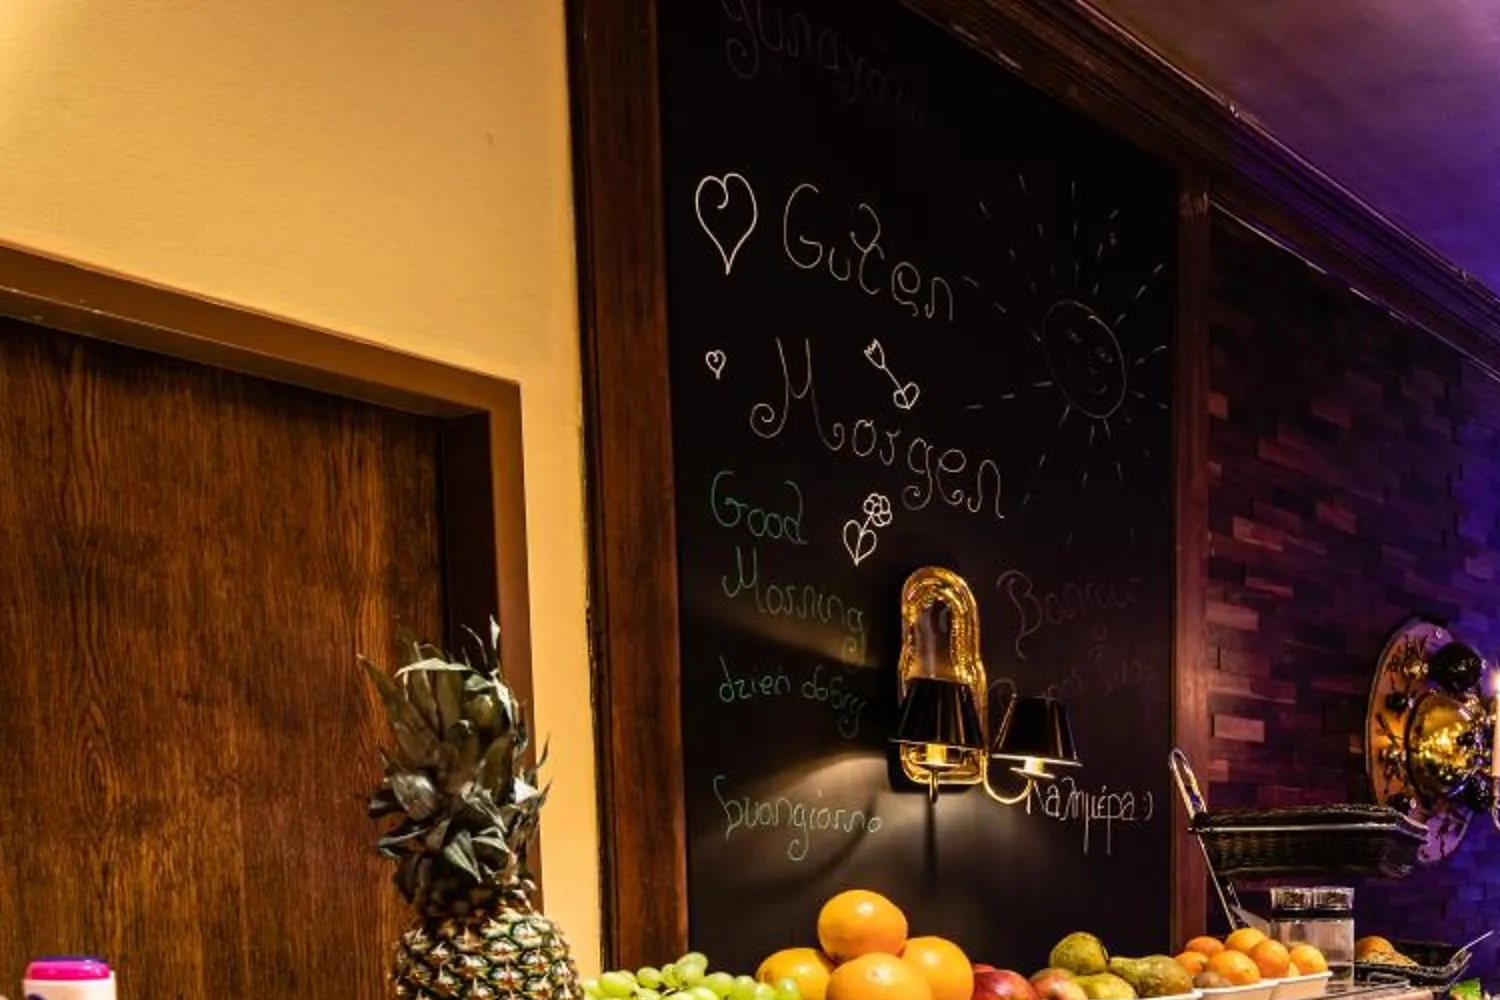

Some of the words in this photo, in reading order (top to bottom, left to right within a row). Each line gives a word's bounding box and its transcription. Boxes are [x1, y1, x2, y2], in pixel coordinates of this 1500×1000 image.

[783, 183, 954, 321] Guten
[749, 335, 1004, 519] Morgen
[710, 468, 808, 545] Good
[721, 545, 868, 664] Morning
